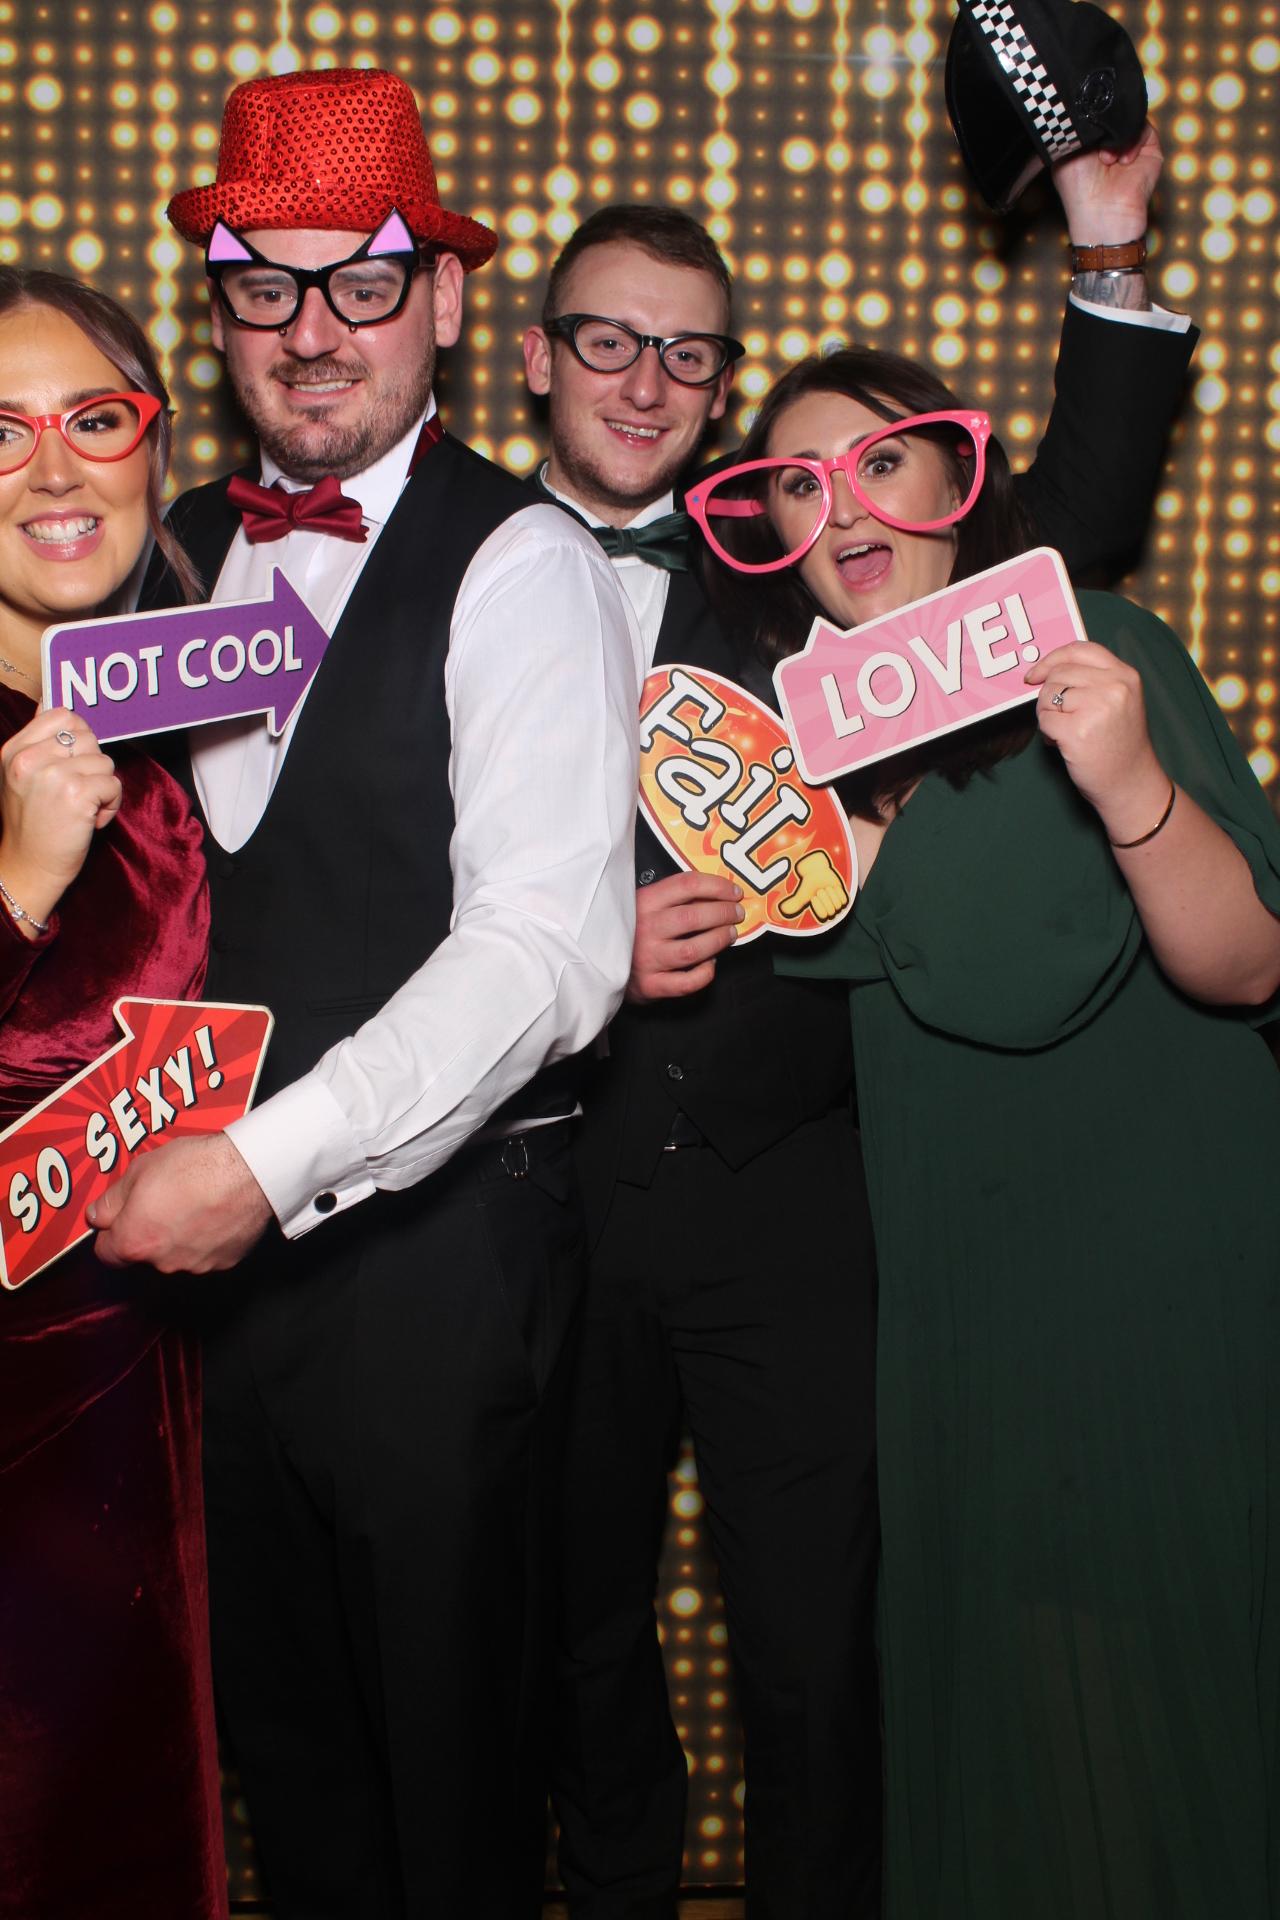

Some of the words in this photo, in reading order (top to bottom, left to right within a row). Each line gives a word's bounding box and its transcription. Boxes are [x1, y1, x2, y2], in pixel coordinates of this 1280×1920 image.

[60, 645, 162, 711] NOT
[177, 625, 303, 688] COOL
[820, 593, 1040, 739] LOVE!
[9, 1146, 72, 1233] SO
[85, 1024, 224, 1174] SEXY!
